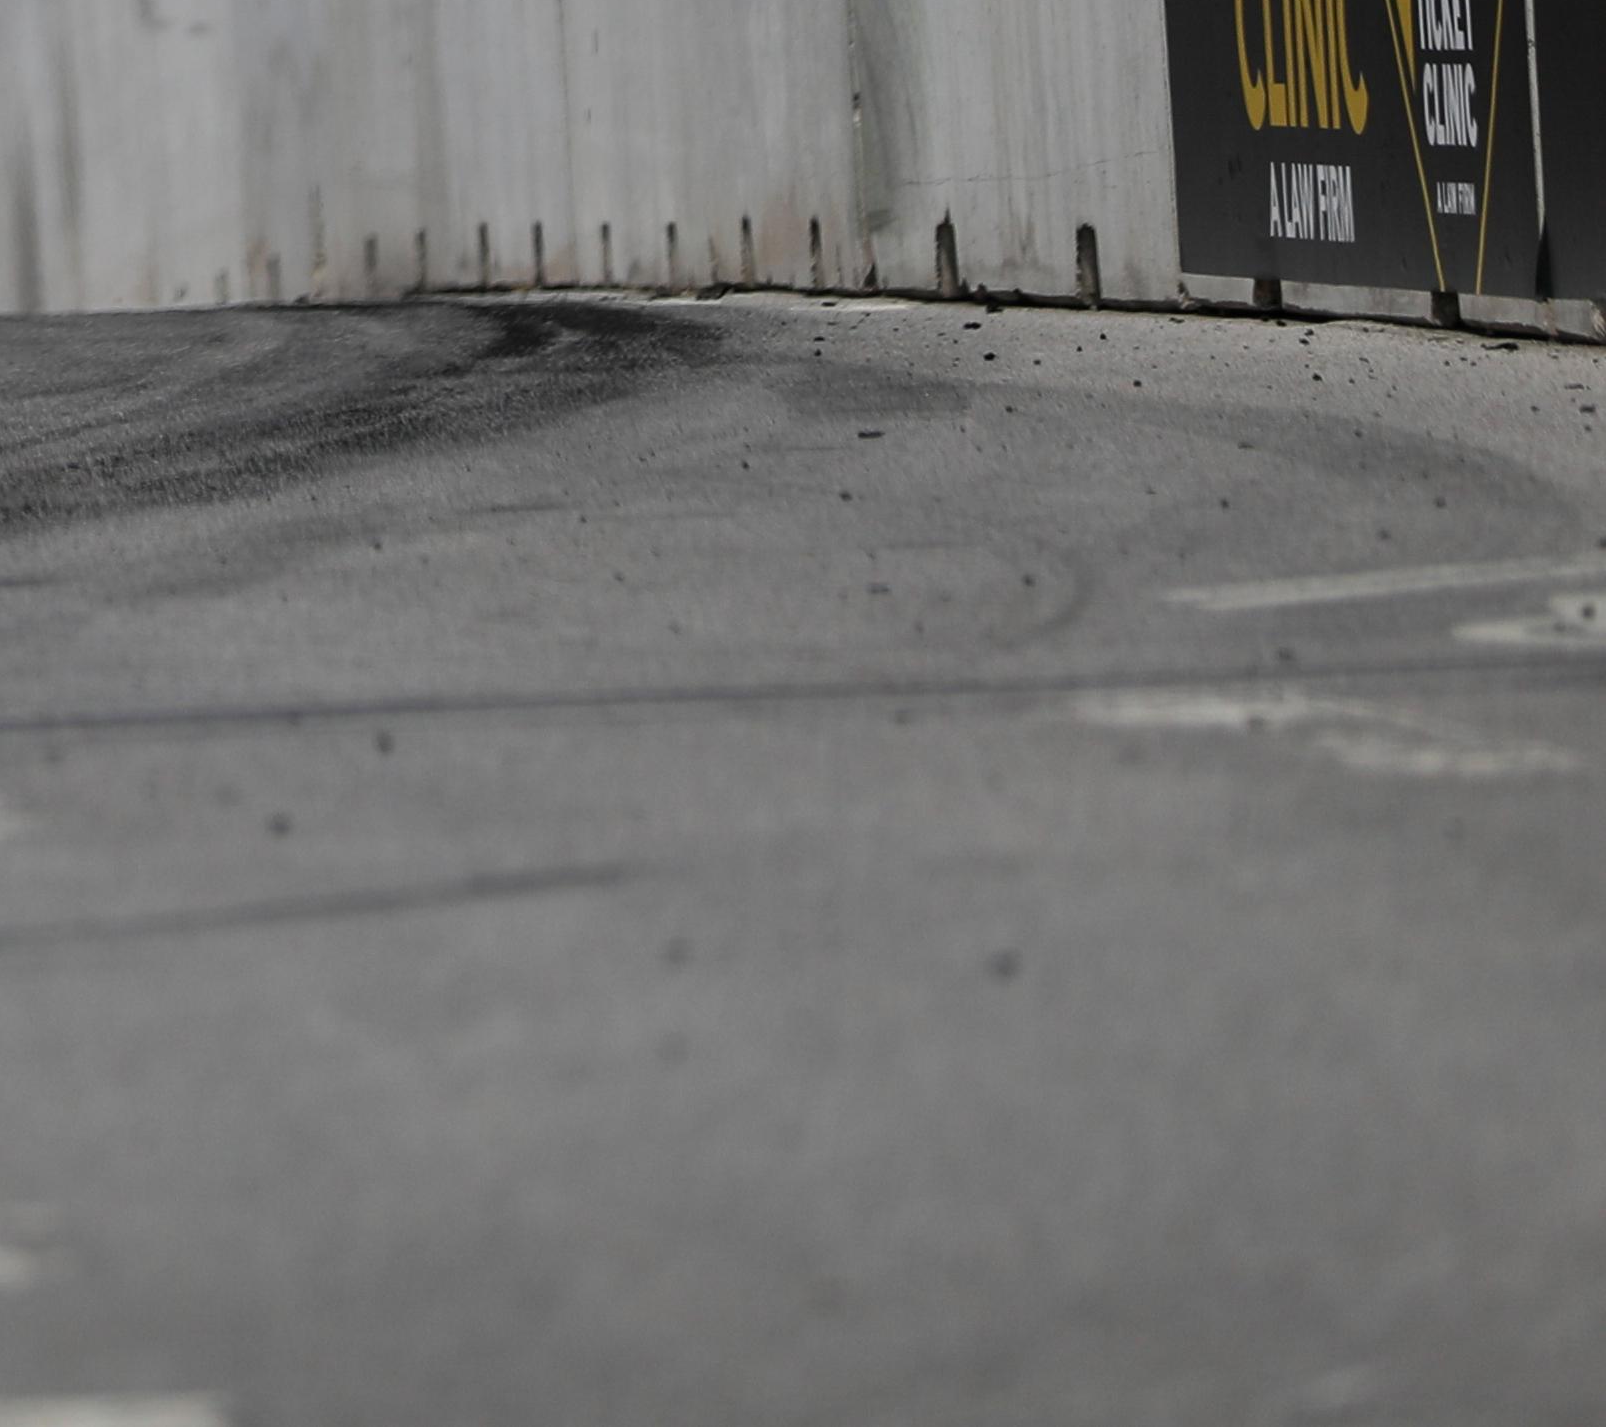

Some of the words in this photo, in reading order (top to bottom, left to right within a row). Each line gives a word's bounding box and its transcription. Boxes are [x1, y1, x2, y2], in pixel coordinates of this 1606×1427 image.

[1423, 62, 1478, 148] CLINIC
[1270, 161, 1283, 237] A
[1281, 162, 1315, 240] LAW
[1316, 164, 1355, 243] FIRM
